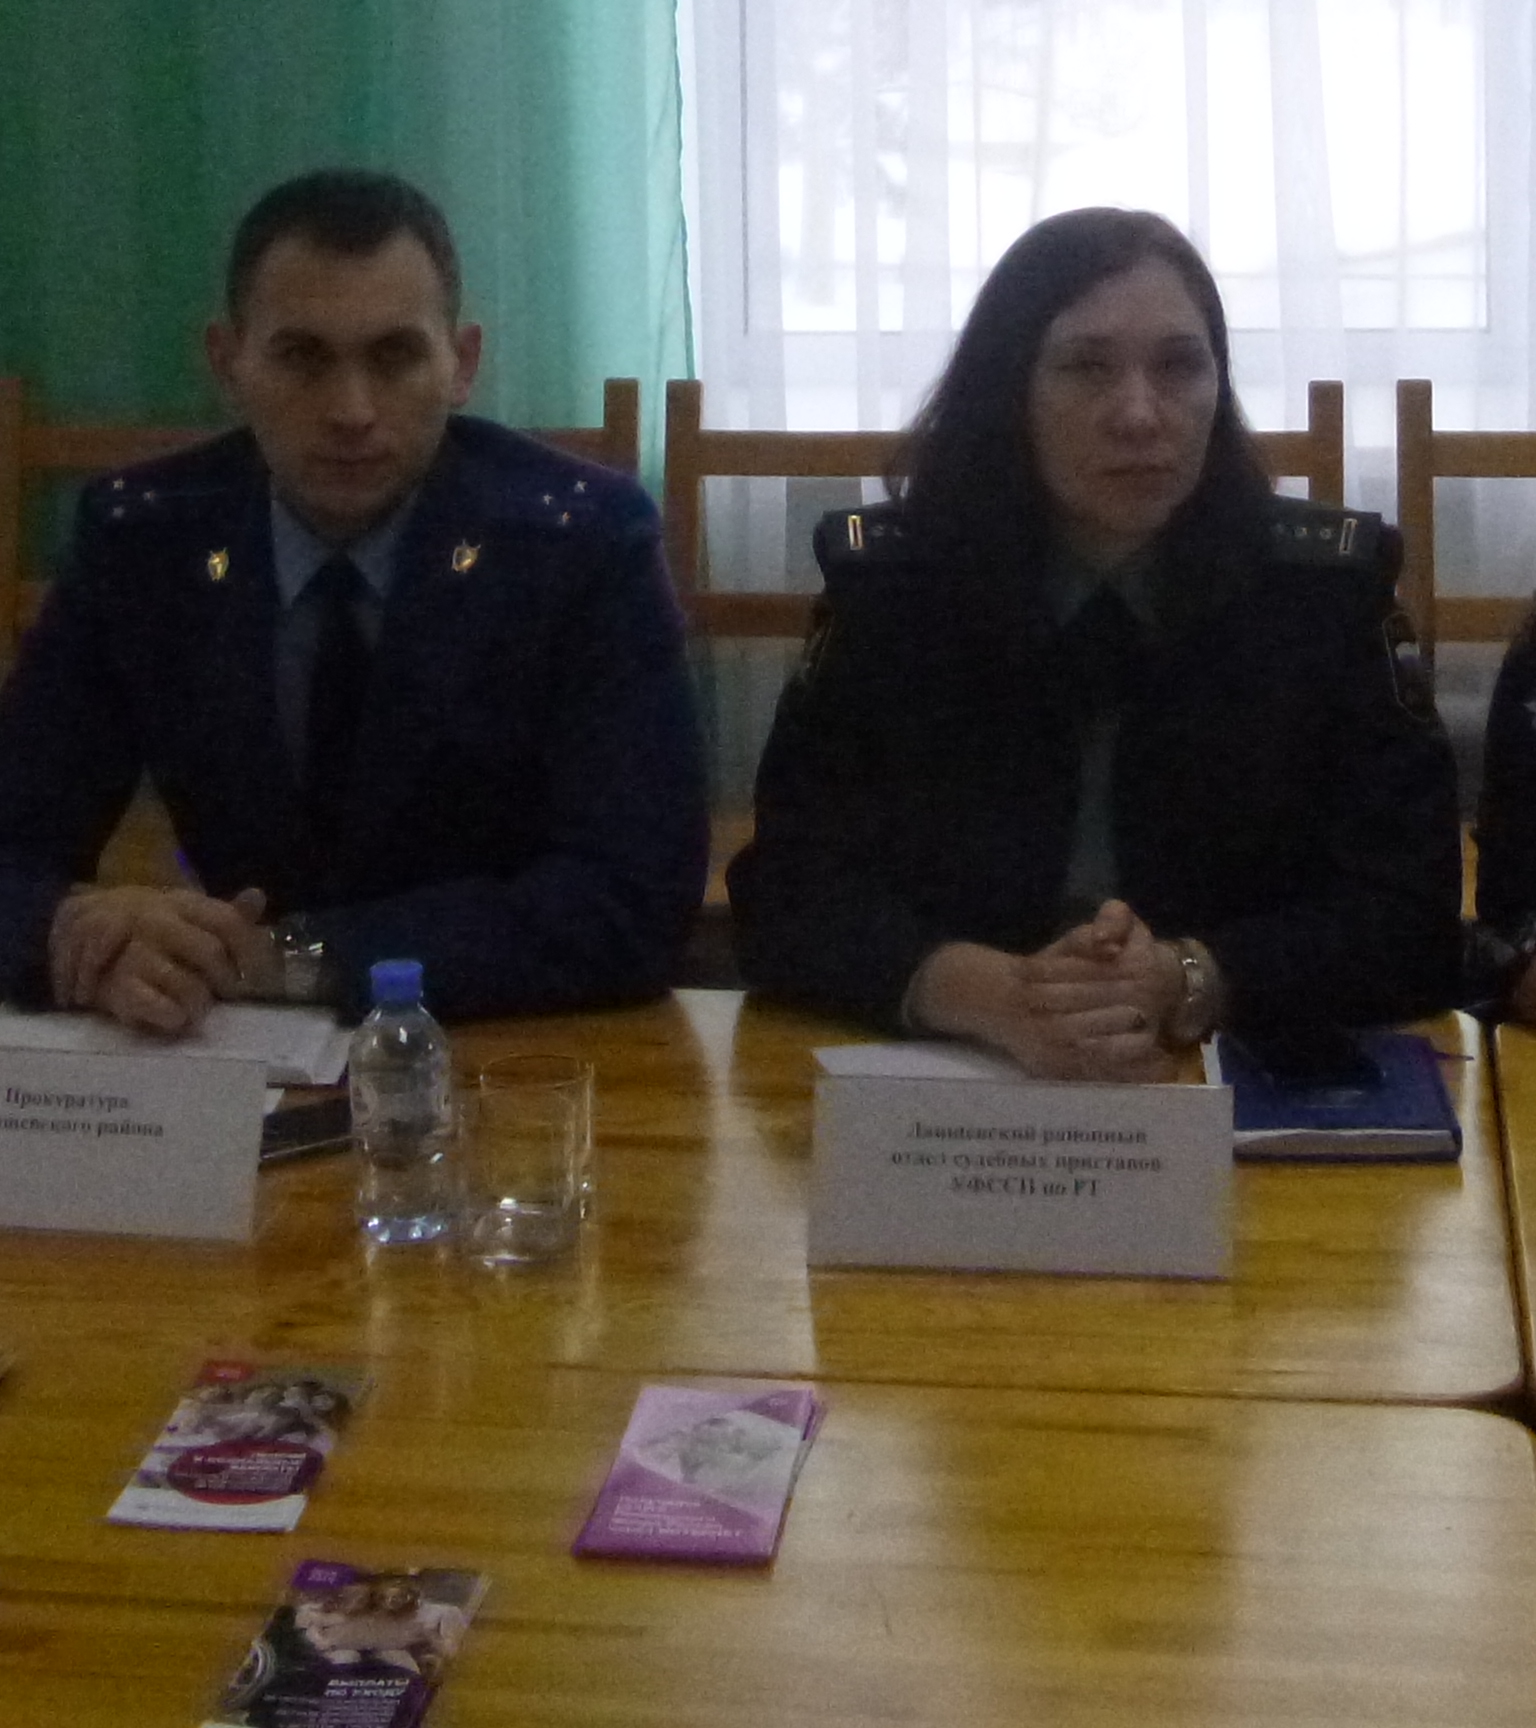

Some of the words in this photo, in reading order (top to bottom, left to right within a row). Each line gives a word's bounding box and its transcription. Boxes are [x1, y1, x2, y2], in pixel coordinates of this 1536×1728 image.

[5, 1087, 130, 1113] Прокуратура
[96, 1119, 164, 1139] района
[1073, 1179, 1100, 1198] РТ
